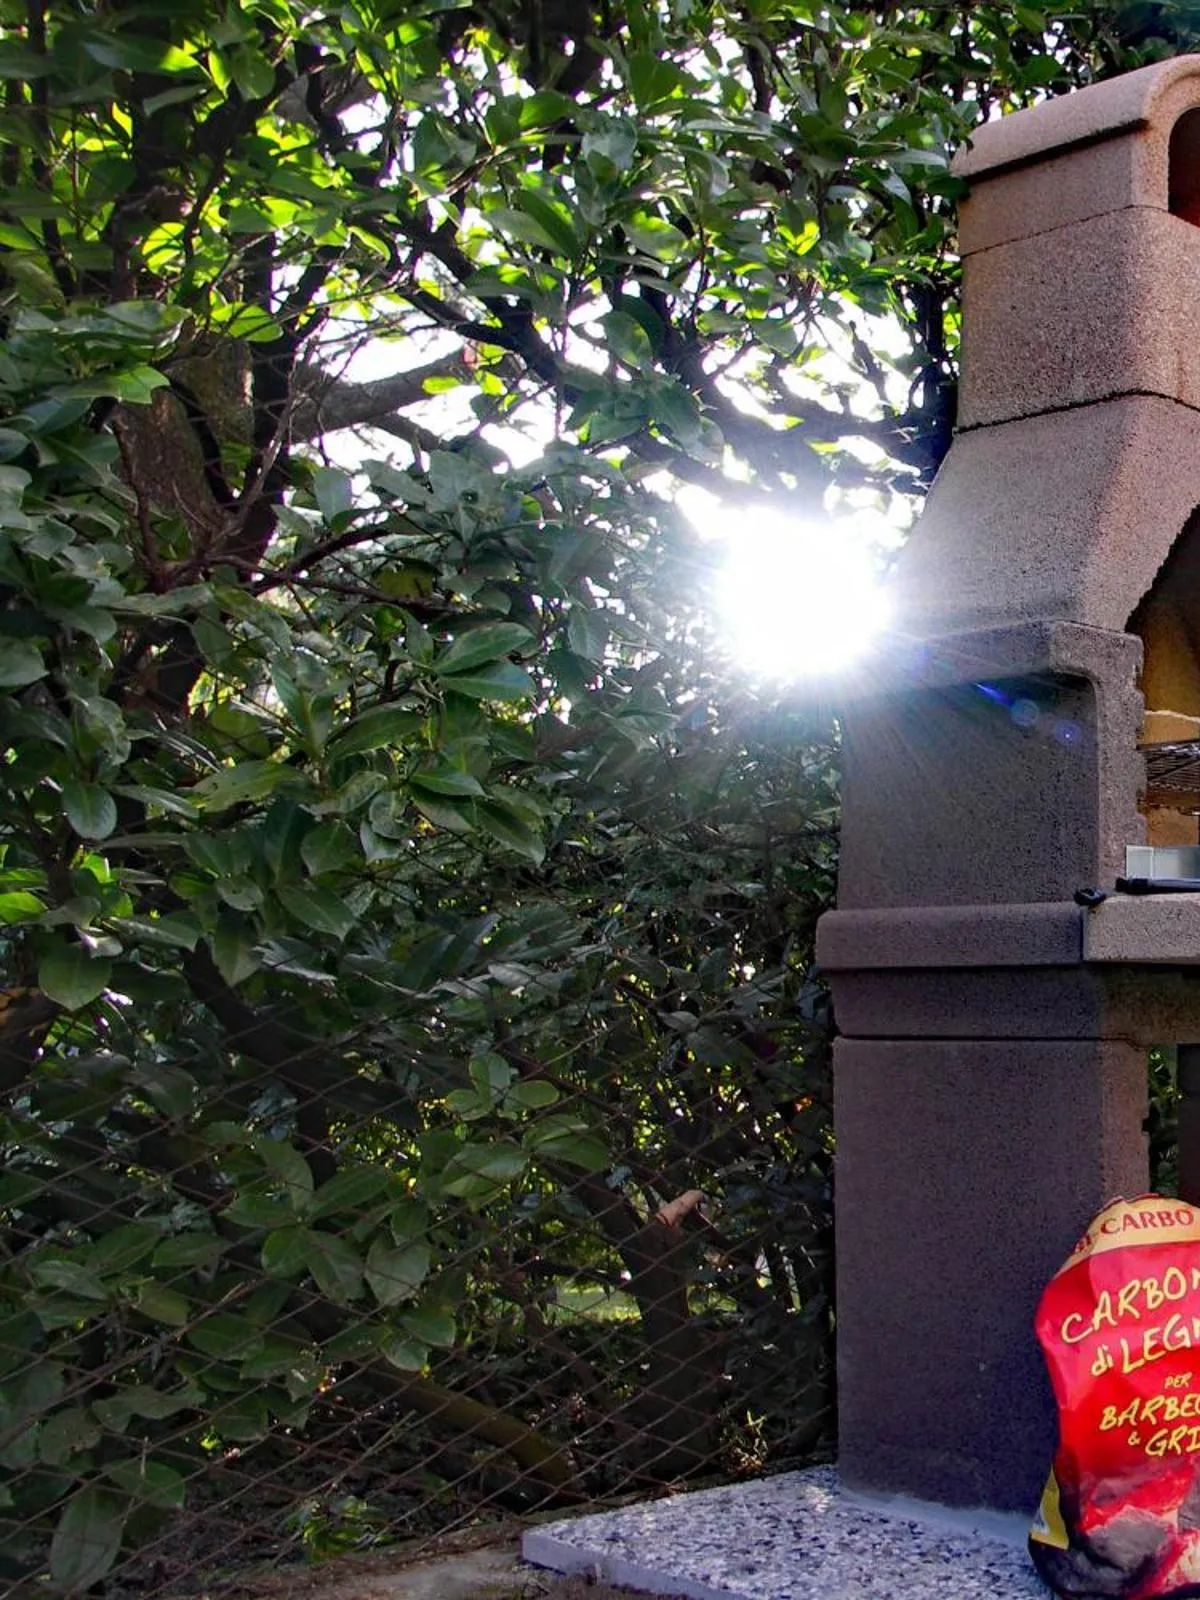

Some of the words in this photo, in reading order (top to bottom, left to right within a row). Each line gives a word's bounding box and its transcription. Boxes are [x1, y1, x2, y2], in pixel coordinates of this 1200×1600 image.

[1100, 1207, 1194, 1234] CARBO
[1090, 1343, 1114, 1376] di
[1164, 1372, 1193, 1390] PER
[1127, 1431, 1141, 1446] &
